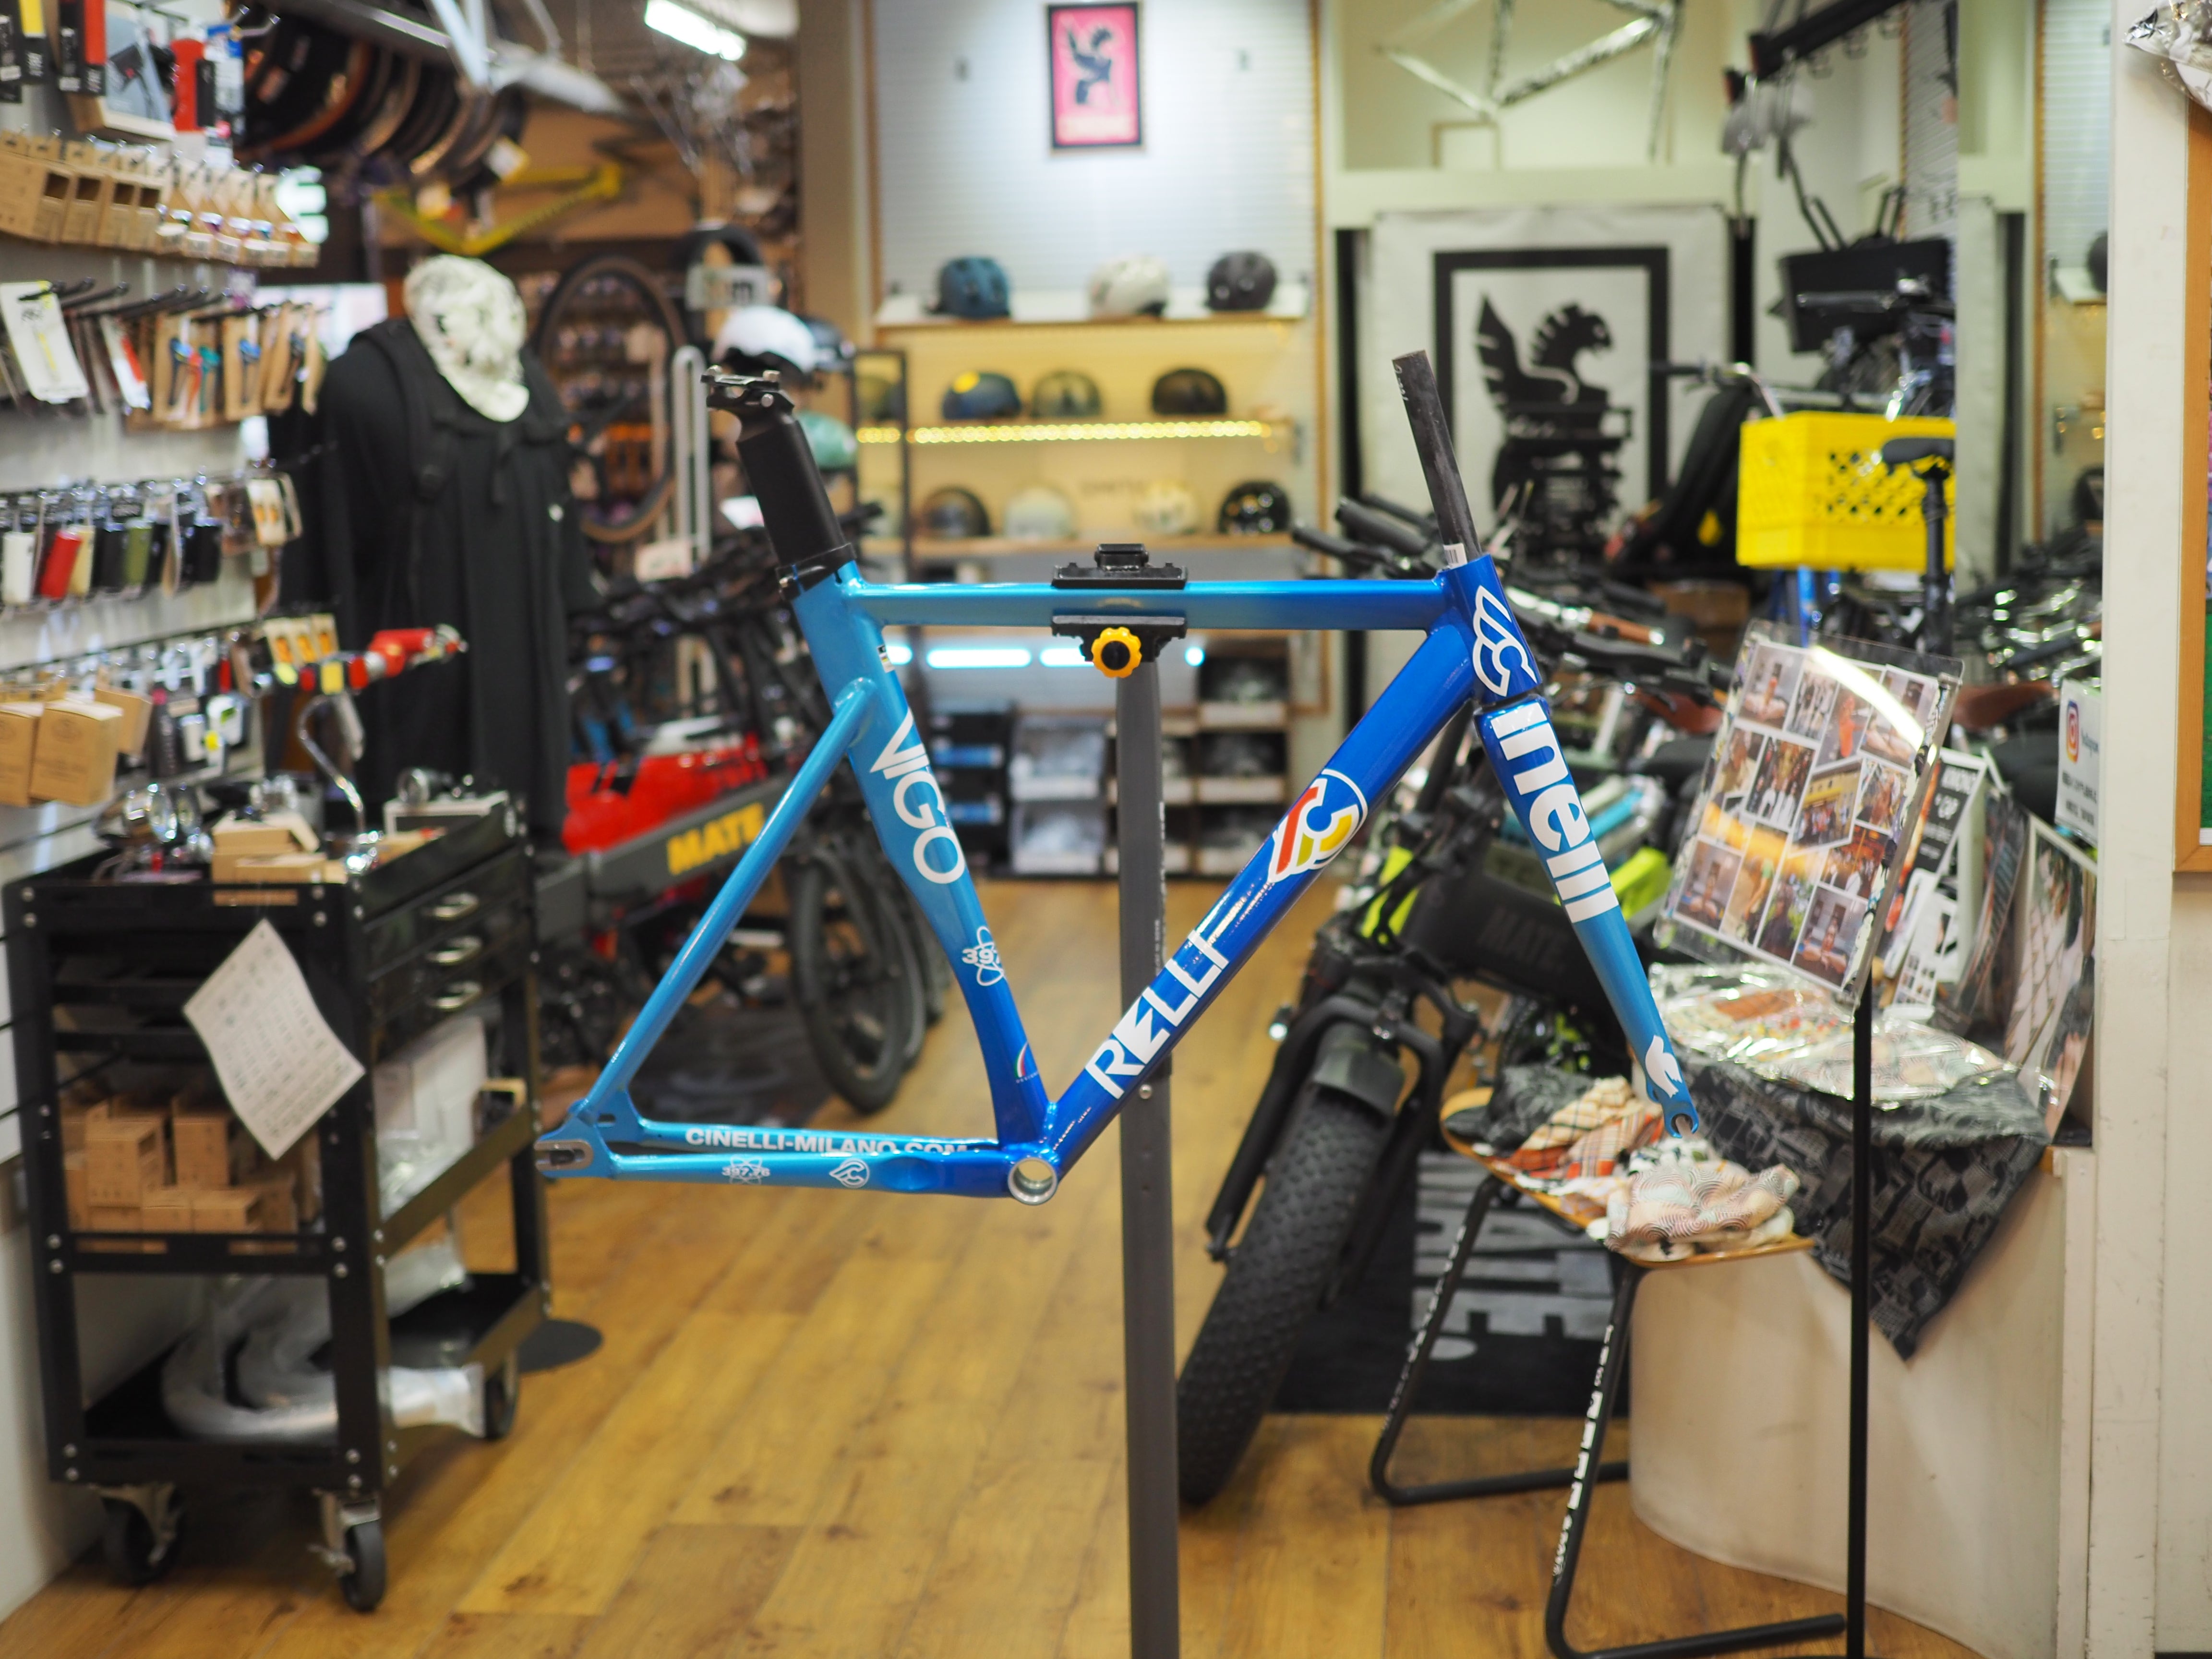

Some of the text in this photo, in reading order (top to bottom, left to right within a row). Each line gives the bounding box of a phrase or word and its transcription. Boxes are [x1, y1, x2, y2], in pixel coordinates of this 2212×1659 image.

[870, 708, 965, 884] VIGO
[1085, 930, 1229, 1100] RELLI
[685, 1127, 968, 1153] CINELLI-MILANOCOM
